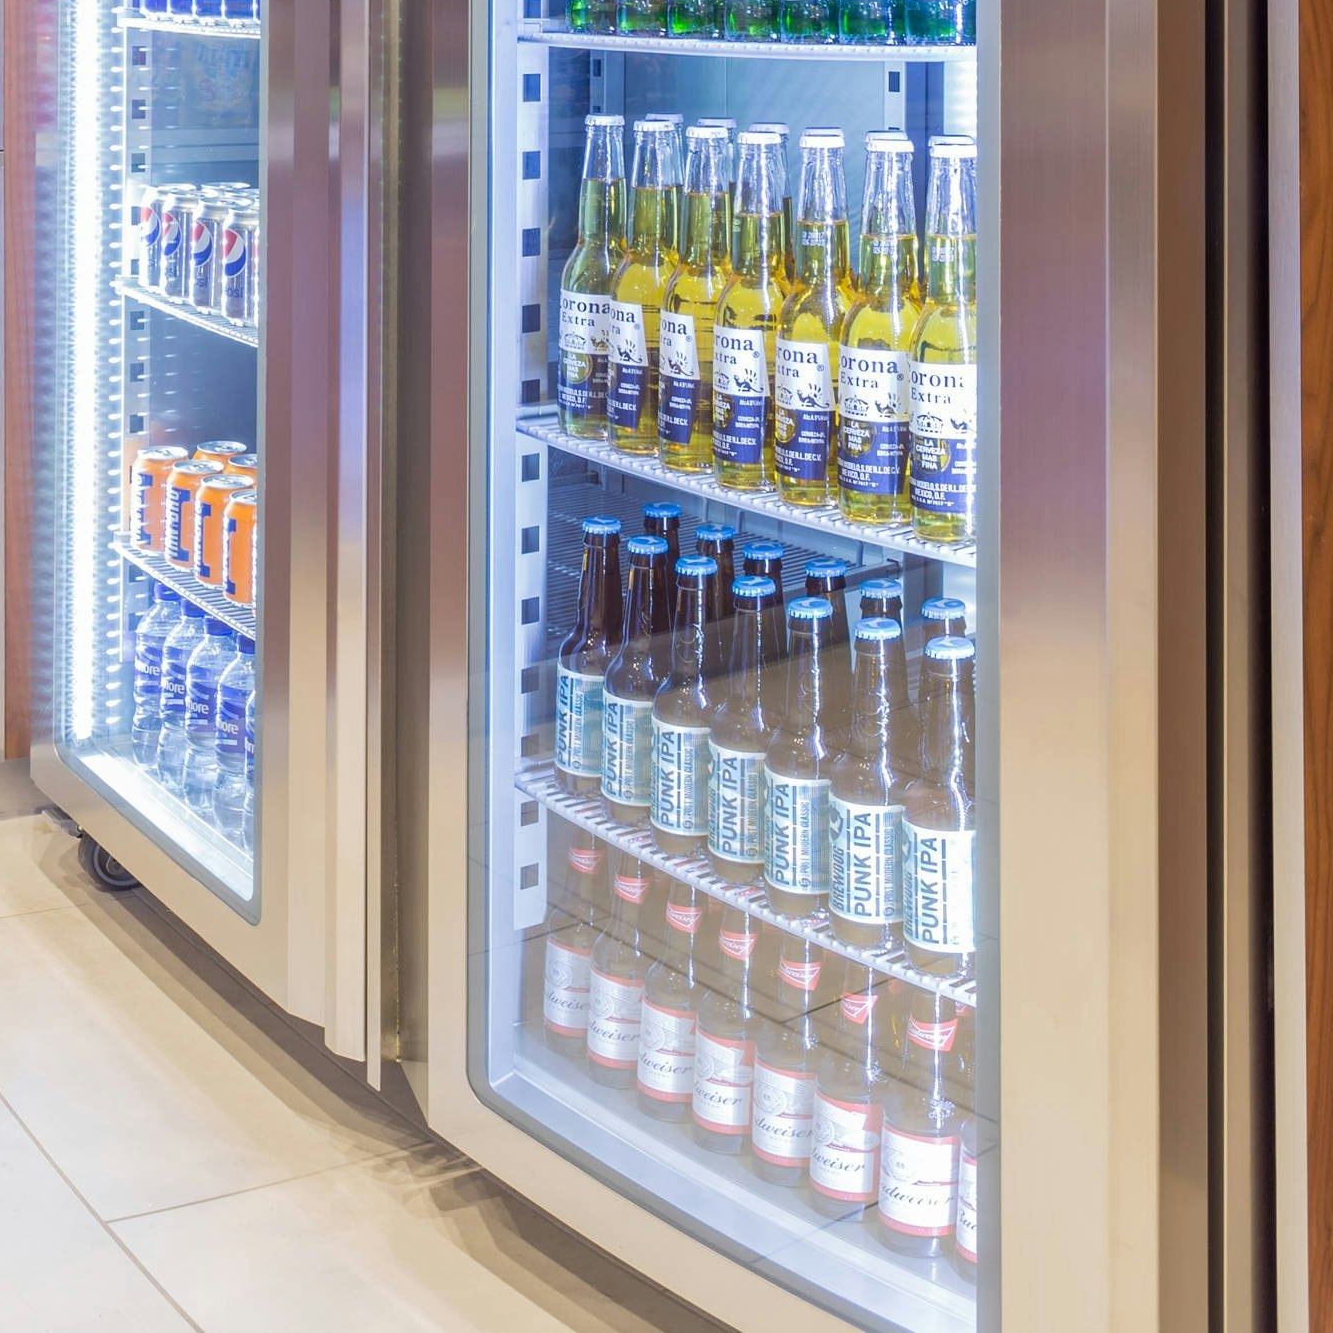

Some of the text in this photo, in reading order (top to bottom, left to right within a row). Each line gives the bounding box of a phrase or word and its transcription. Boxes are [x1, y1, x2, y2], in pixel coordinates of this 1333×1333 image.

[562, 312, 595, 327] Extra
[841, 355, 898, 374] orona
[840, 372, 878, 389] Extra
[911, 387, 952, 404] Extra
[843, 427, 870, 438] CERVEZA
[916, 445, 946, 456] CERVEZA
[921, 461, 938, 470] FINA
[557, 675, 569, 765] PUNK IPA
[605, 702, 618, 796] PUNK IPA
[661, 731, 675, 827] PUNK IPA
[722, 757, 738, 855] PUNK IPA
[775, 783, 790, 885] PUNK IPA
[854, 812, 872, 916] PUNK IPA
[833, 847, 844, 912] BREWDOG
[920, 837, 939, 944] PUNK IPA
[638, 1051, 691, 1076] dweiser
[755, 1116, 813, 1138] dweiser
